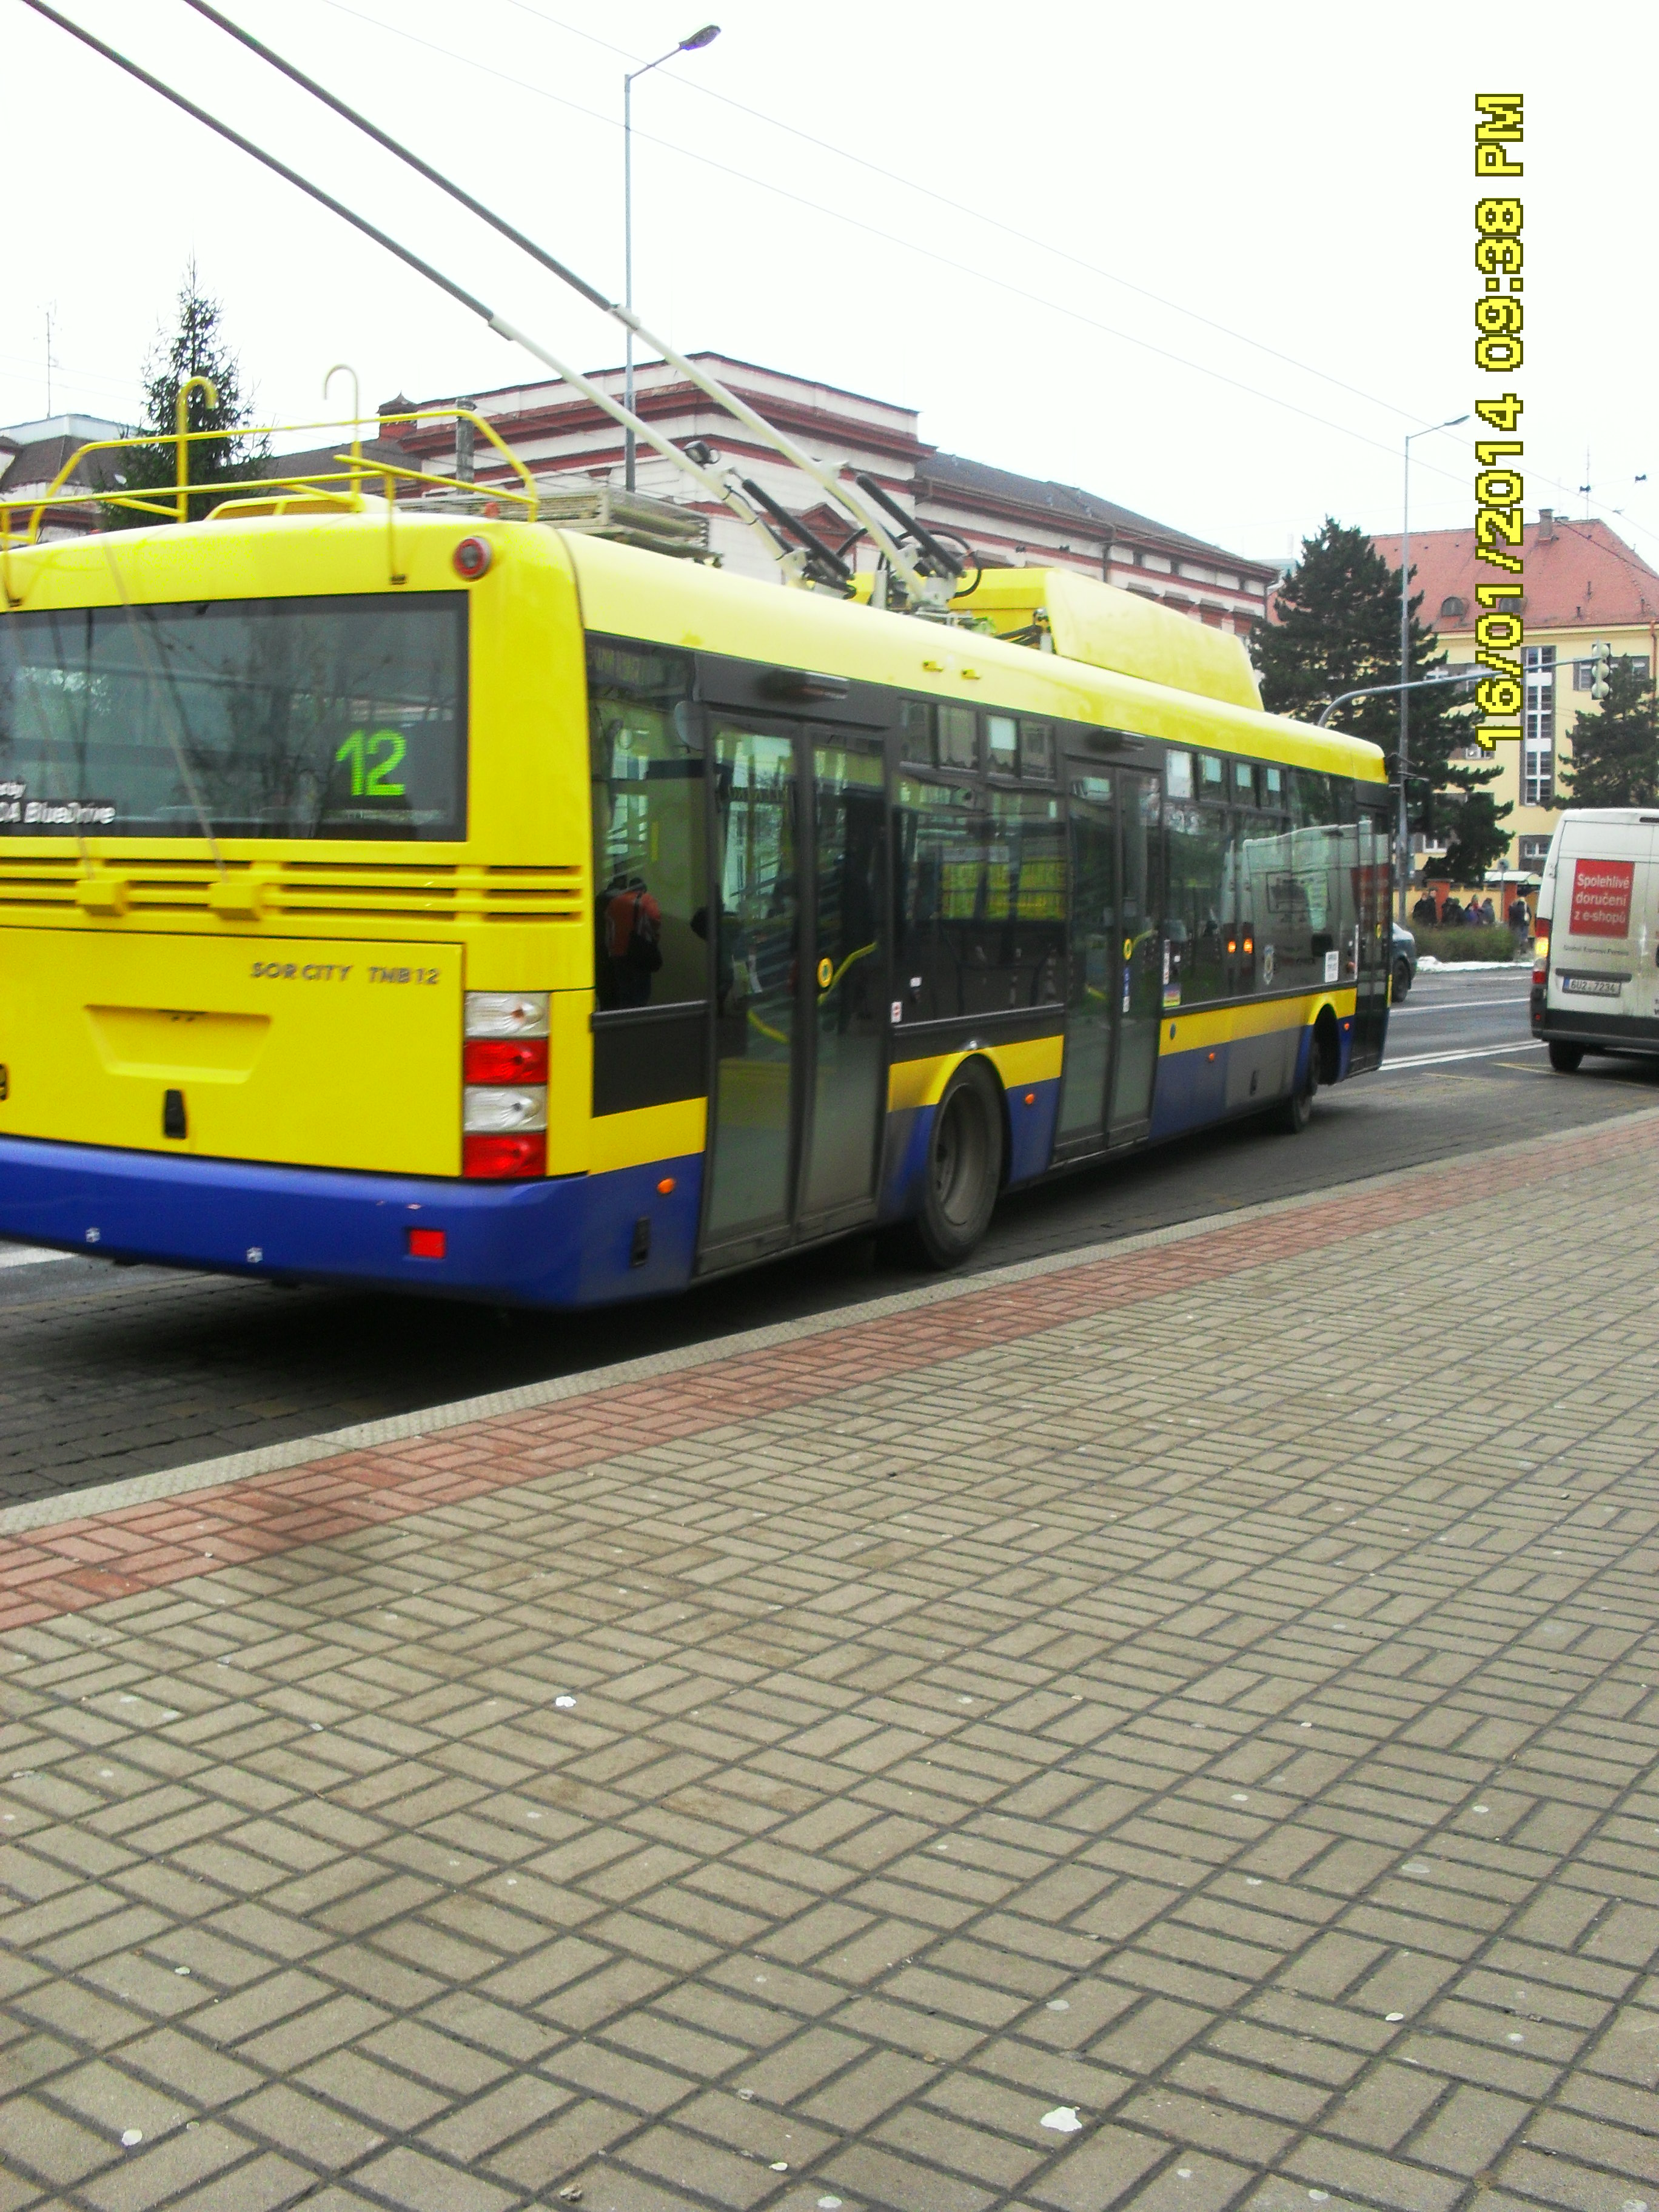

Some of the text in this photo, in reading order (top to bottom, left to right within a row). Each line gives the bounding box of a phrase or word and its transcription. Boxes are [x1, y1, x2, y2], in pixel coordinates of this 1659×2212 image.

[336, 729, 407, 796] 12
[1577, 874, 1629, 889] Spolehlivé
[1576, 891, 1626, 907] doručení
[1574, 911, 1580, 920] z
